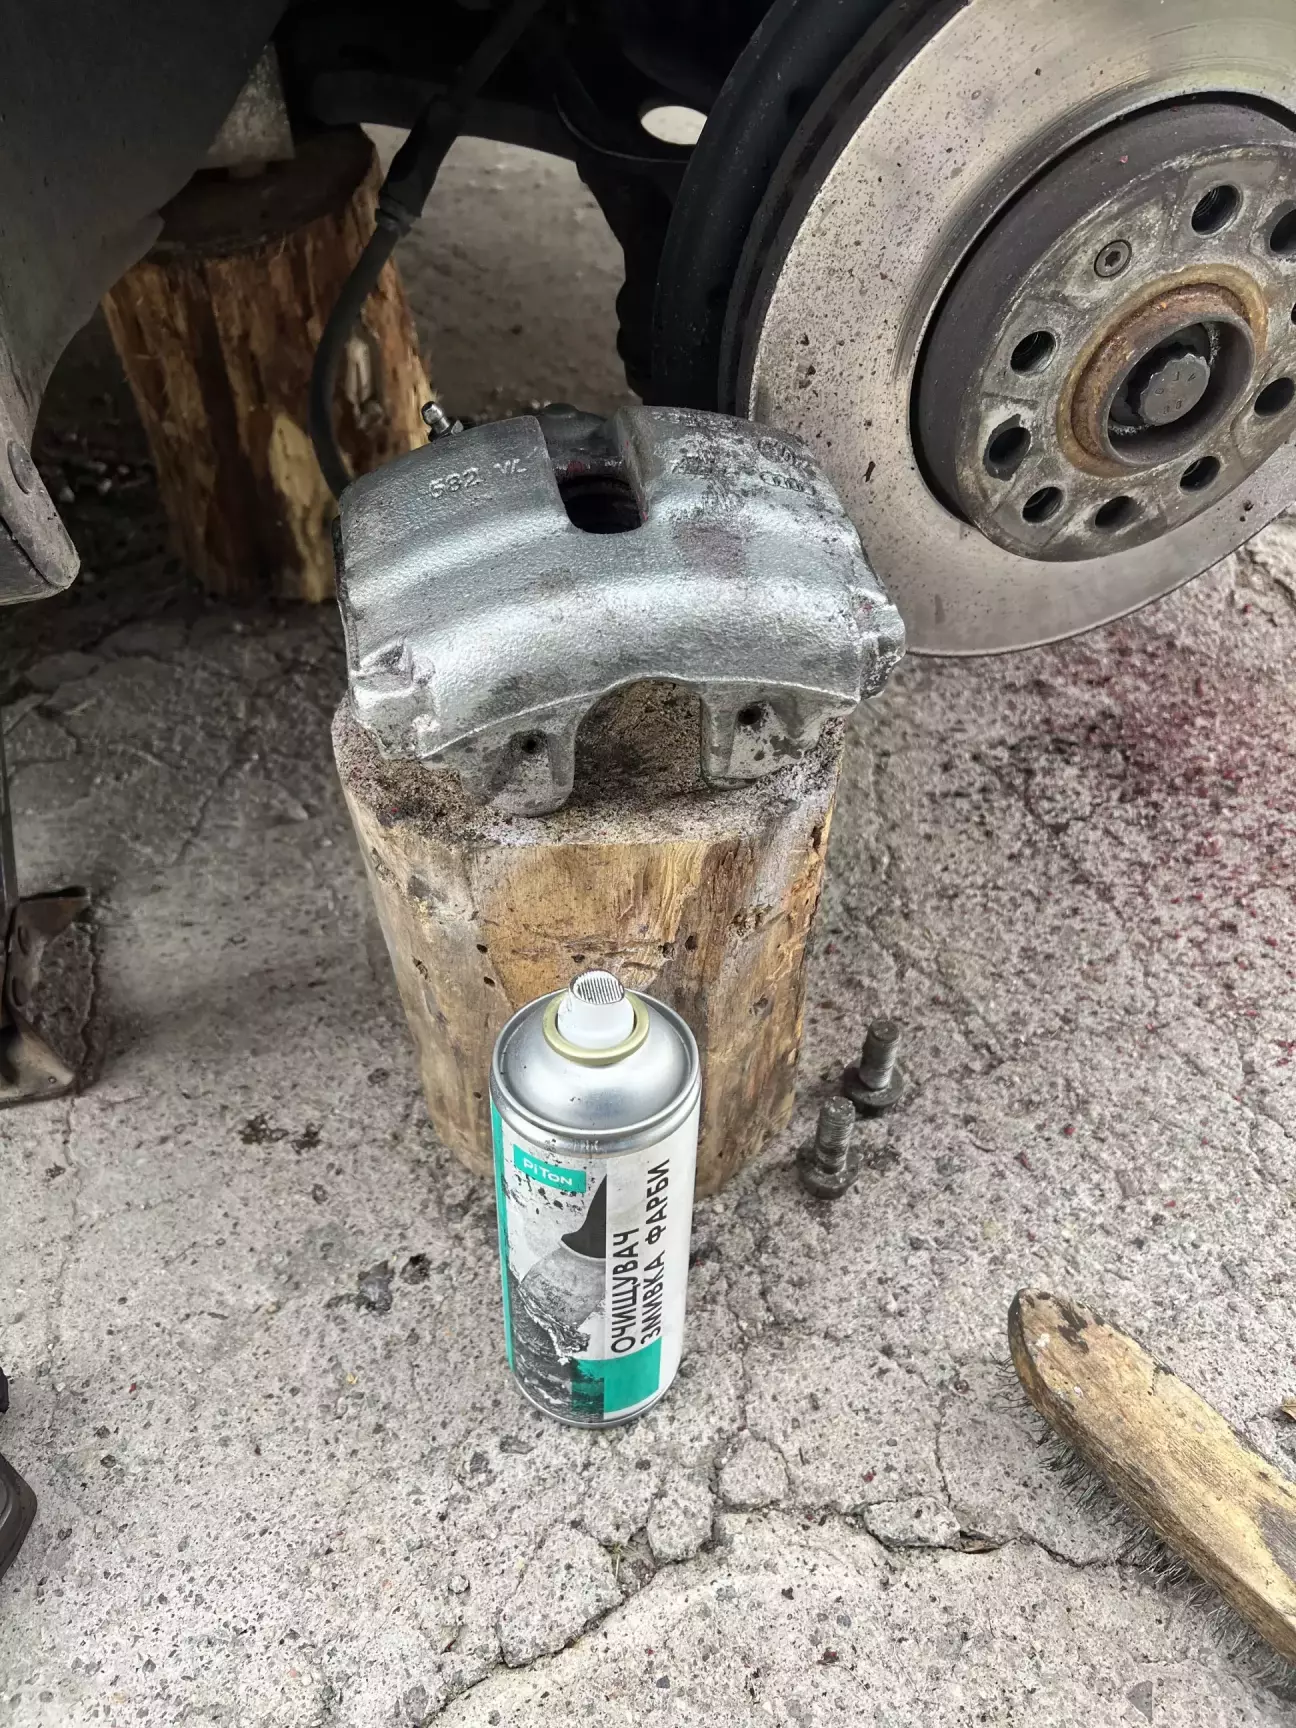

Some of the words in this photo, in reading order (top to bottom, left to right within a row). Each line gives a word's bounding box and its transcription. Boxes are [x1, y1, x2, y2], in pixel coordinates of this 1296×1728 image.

[644, 1158, 671, 1246] ФАРБИ
[610, 1227, 640, 1353] ОЧИЩУВАЧ
[640, 1250, 665, 1346] ЗМИВКА
